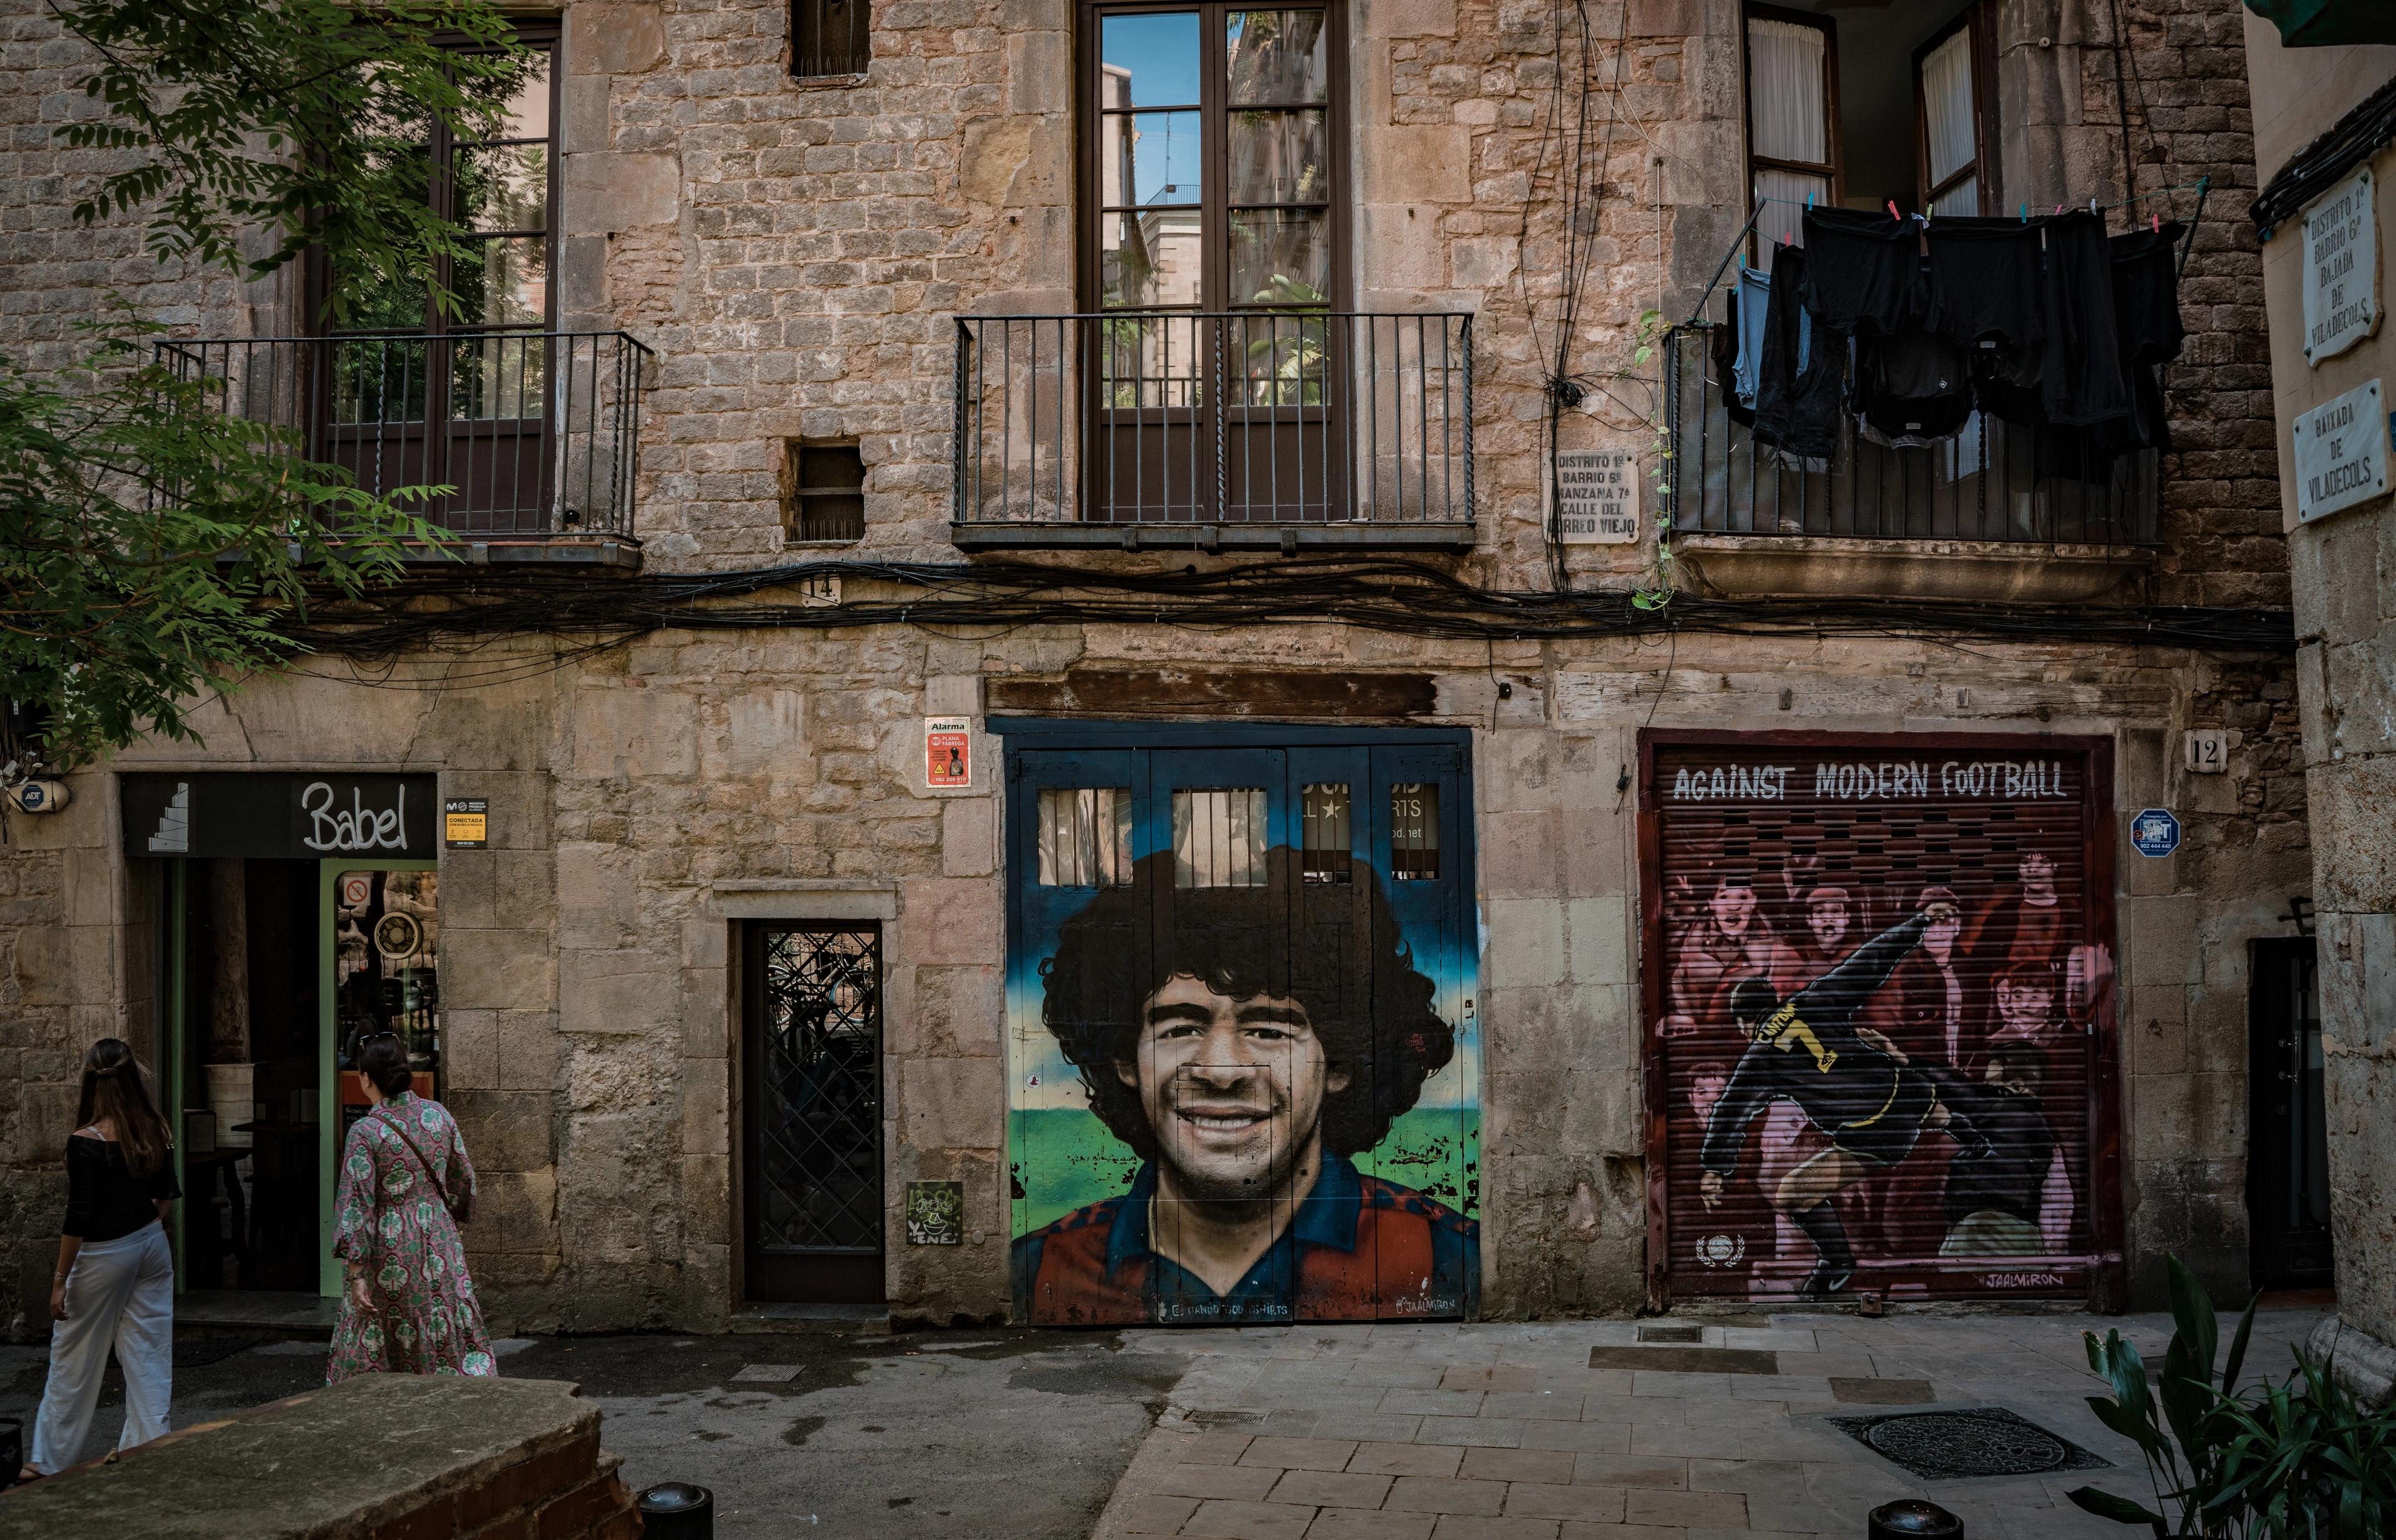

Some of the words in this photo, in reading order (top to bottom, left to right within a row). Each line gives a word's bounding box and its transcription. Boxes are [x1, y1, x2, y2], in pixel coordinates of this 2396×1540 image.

[2311, 196, 2352, 241] DISTRITO
[2314, 226, 2345, 265] BARRIO
[2321, 249, 2354, 288] BAJADA
[2331, 284, 2344, 309] DE
[2311, 298, 2368, 348] VILADECOLS
[2316, 403, 2354, 437] BAIXADA
[2330, 437, 2343, 461] DE
[1559, 456, 1609, 468] DISTRITO
[1562, 472, 1605, 484] BARRIO
[2309, 456, 2371, 505] VILADECOLS
[1561, 503, 1597, 515] CALLE
[1602, 503, 1624, 515] DEL
[1600, 519, 1635, 533] VIEJO
[2194, 740, 2218, 763] 12
[1673, 764, 1796, 801] AGAINST
[1815, 761, 1929, 801] MODERN
[1941, 761, 2068, 797] FOOTBALL
[25, 792, 41, 800] ADT
[302, 781, 407, 850] Babel
[1986, 1273, 2064, 1288] JAALMIRON
